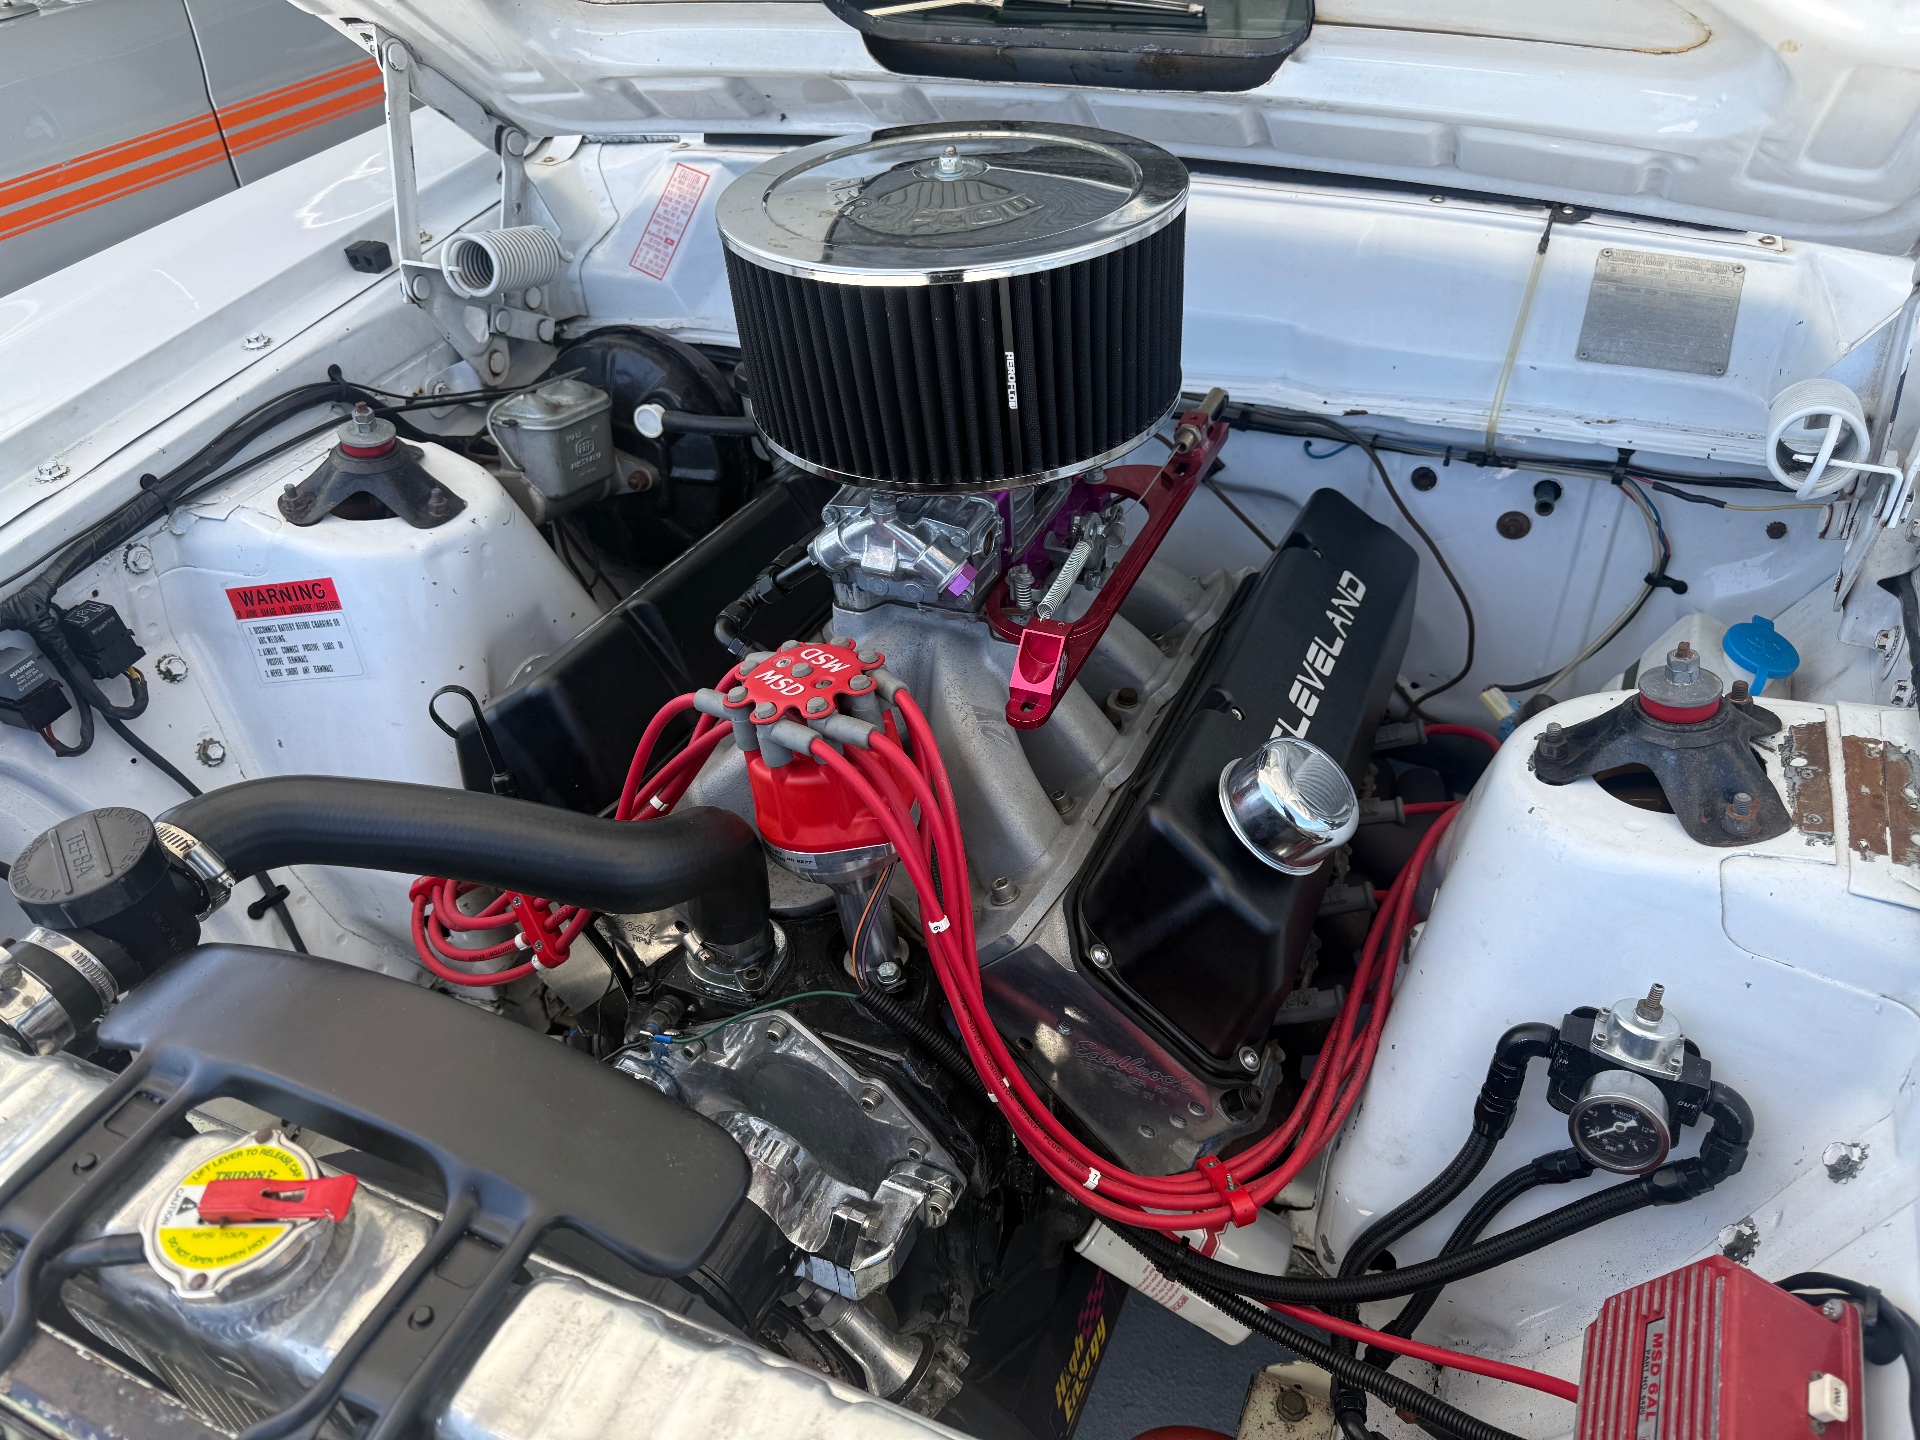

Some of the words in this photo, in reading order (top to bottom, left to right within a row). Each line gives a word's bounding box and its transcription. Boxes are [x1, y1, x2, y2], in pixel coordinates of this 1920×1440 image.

[1004, 351, 1019, 410] AEROFLOW
[237, 582, 326, 607] WARNING
[10, 660, 35, 679] NARVA
[800, 648, 851, 673] MSD
[754, 669, 805, 696] MSD
[95, 808, 145, 827] CLEAN
[66, 830, 95, 879] TEFBA
[113, 828, 150, 871] FILTER
[12, 838, 61, 900] FREQUENTLY
[490, 943, 515, 957] NDUCTOR
[1072, 1040, 1193, 1094] Edelbrock
[967, 1018, 983, 1047] SUPER
[983, 1053, 1015, 1101] CONDUCTOR
[1018, 1107, 1039, 1132] SPARK
[1043, 1135, 1062, 1154] PLUG
[1068, 1156, 1087, 1173] WIRE
[192, 1163, 212, 1182] LIFT
[212, 1150, 244, 1168] LEVER
[246, 1149, 259, 1157] TO
[261, 1148, 294, 1167] RELEASE
[289, 1163, 302, 1178] CAP
[215, 1170, 267, 1180] TRIDON
[161, 1187, 185, 1226] CAUTION
[167, 1236, 179, 1248] DO
[175, 1244, 191, 1261] NOT
[189, 1255, 215, 1264] OPEN
[216, 1249, 247, 1264] WHEN
[247, 1235, 268, 1252] HOT
[1064, 1314, 1106, 1423] Energy
[1643, 1349, 1651, 1373] PART
[1650, 1333, 1664, 1377] MSD
[1645, 1382, 1658, 1422] 6AL
